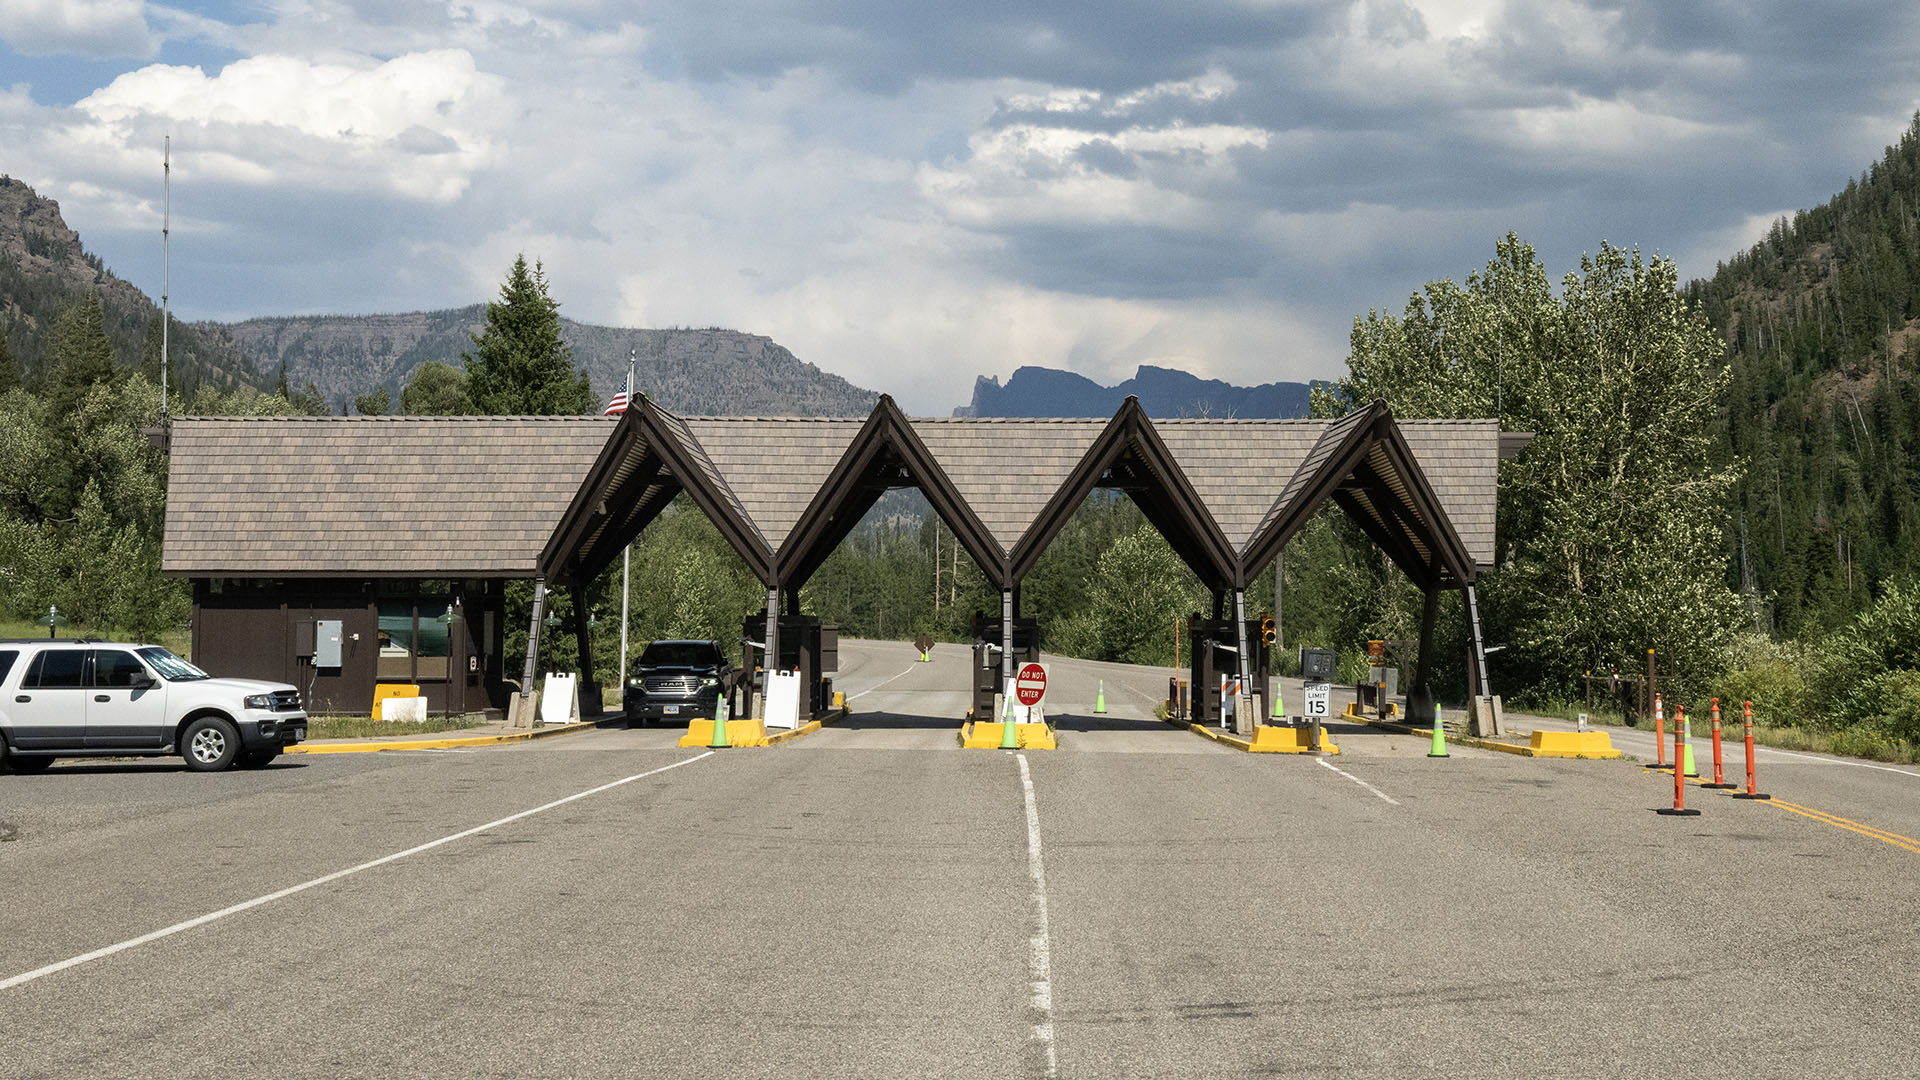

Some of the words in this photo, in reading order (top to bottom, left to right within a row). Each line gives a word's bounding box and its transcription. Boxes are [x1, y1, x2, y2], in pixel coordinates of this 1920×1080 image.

[1032, 672, 1044, 680] NOT
[1021, 690, 1039, 698] ENTER
[1308, 700, 1326, 714] 15
